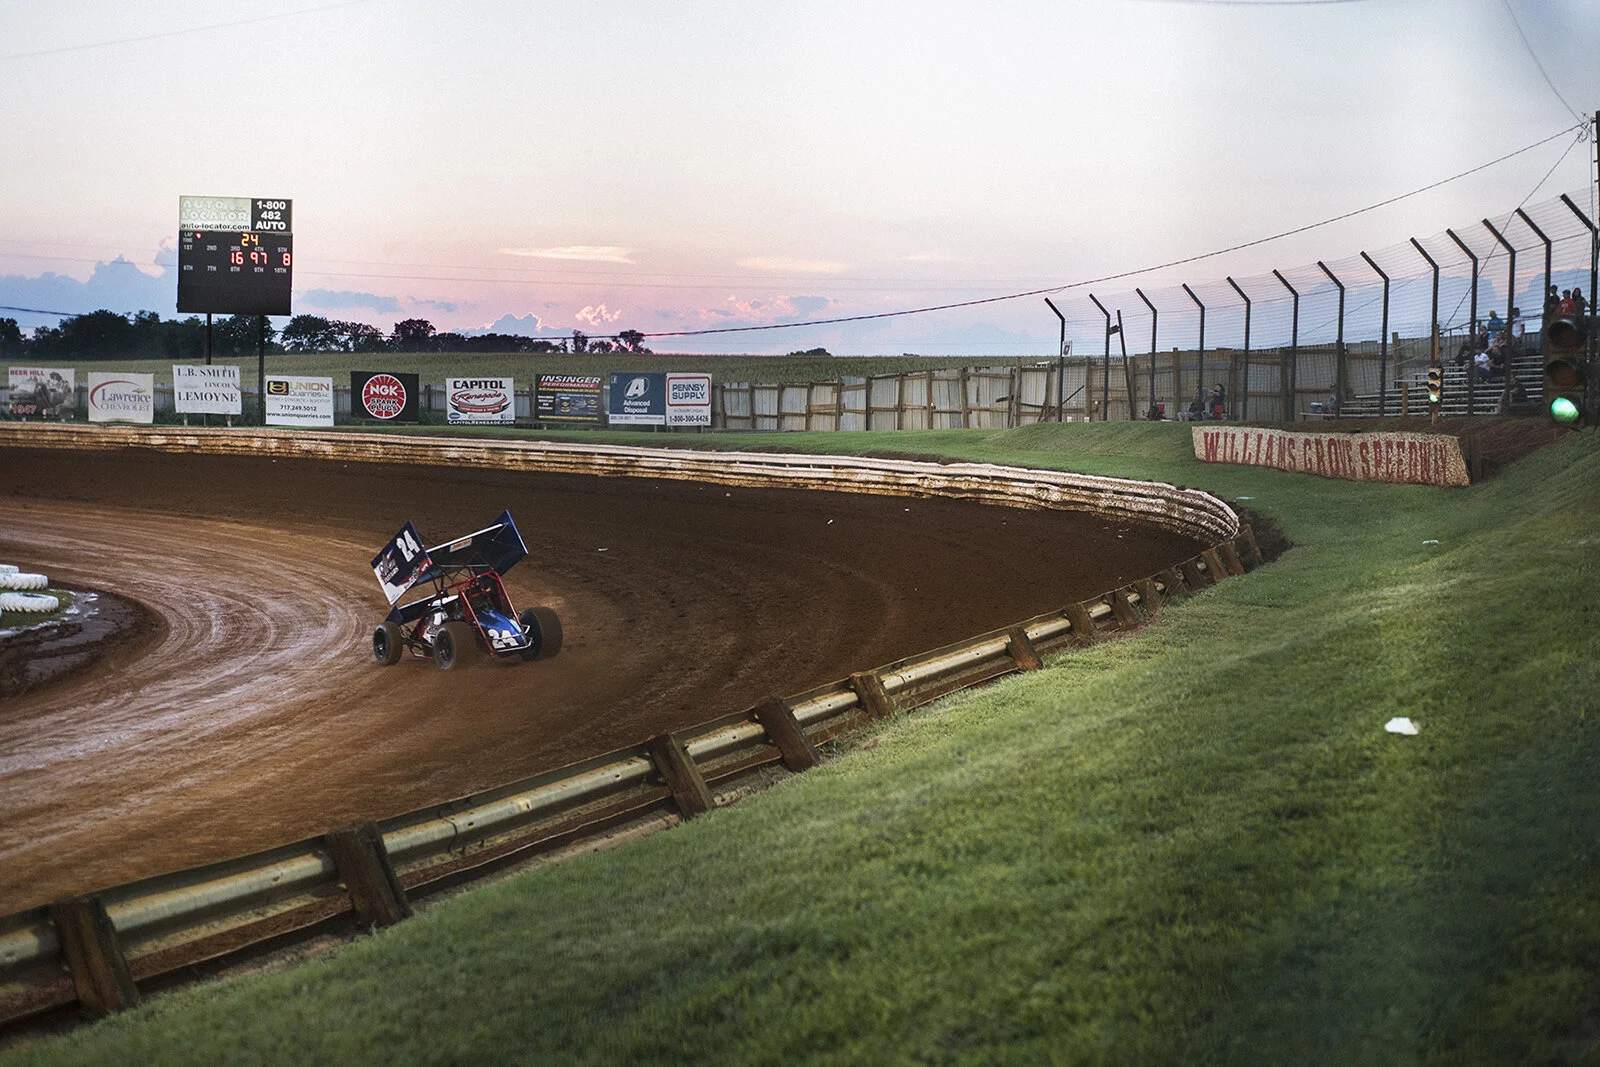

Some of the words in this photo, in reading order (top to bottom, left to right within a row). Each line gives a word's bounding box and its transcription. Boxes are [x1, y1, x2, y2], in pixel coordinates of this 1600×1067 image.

[182, 199, 224, 210] AUTO
[257, 201, 287, 210] 1-800
[181, 210, 248, 221] LOCATOR
[261, 211, 281, 220] 482
[181, 222, 250, 230] auto-locator.com
[255, 221, 287, 231] AUTO
[241, 233, 259, 247] 24
[230, 252, 244, 265] 16
[250, 252, 268, 265] 97
[282, 253, 291, 266] 8
[177, 368, 198, 377] L.B.
[200, 369, 236, 379] SMITH
[453, 380, 506, 389] CAPITOL
[540, 375, 601, 384] INSINGER
[289, 381, 330, 391] UNION
[370, 384, 398, 396] NGK
[672, 383, 705, 392] PENNSY
[101, 388, 151, 403] Lawrence
[177, 391, 238, 403] LEMOYNE
[455, 392, 502, 403] Renegade
[672, 392, 706, 400] SUPPLY
[12, 404, 37, 415] 1947
[101, 403, 150, 412] CHEVROLET
[370, 404, 398, 412] PLUGS
[624, 406, 648, 414] Disposal
[266, 412, 332, 420] www.unionquarries.com
[1302, 437, 1357, 480] GROVE
[396, 530, 420, 562] 24
[487, 628, 520, 649] 24
